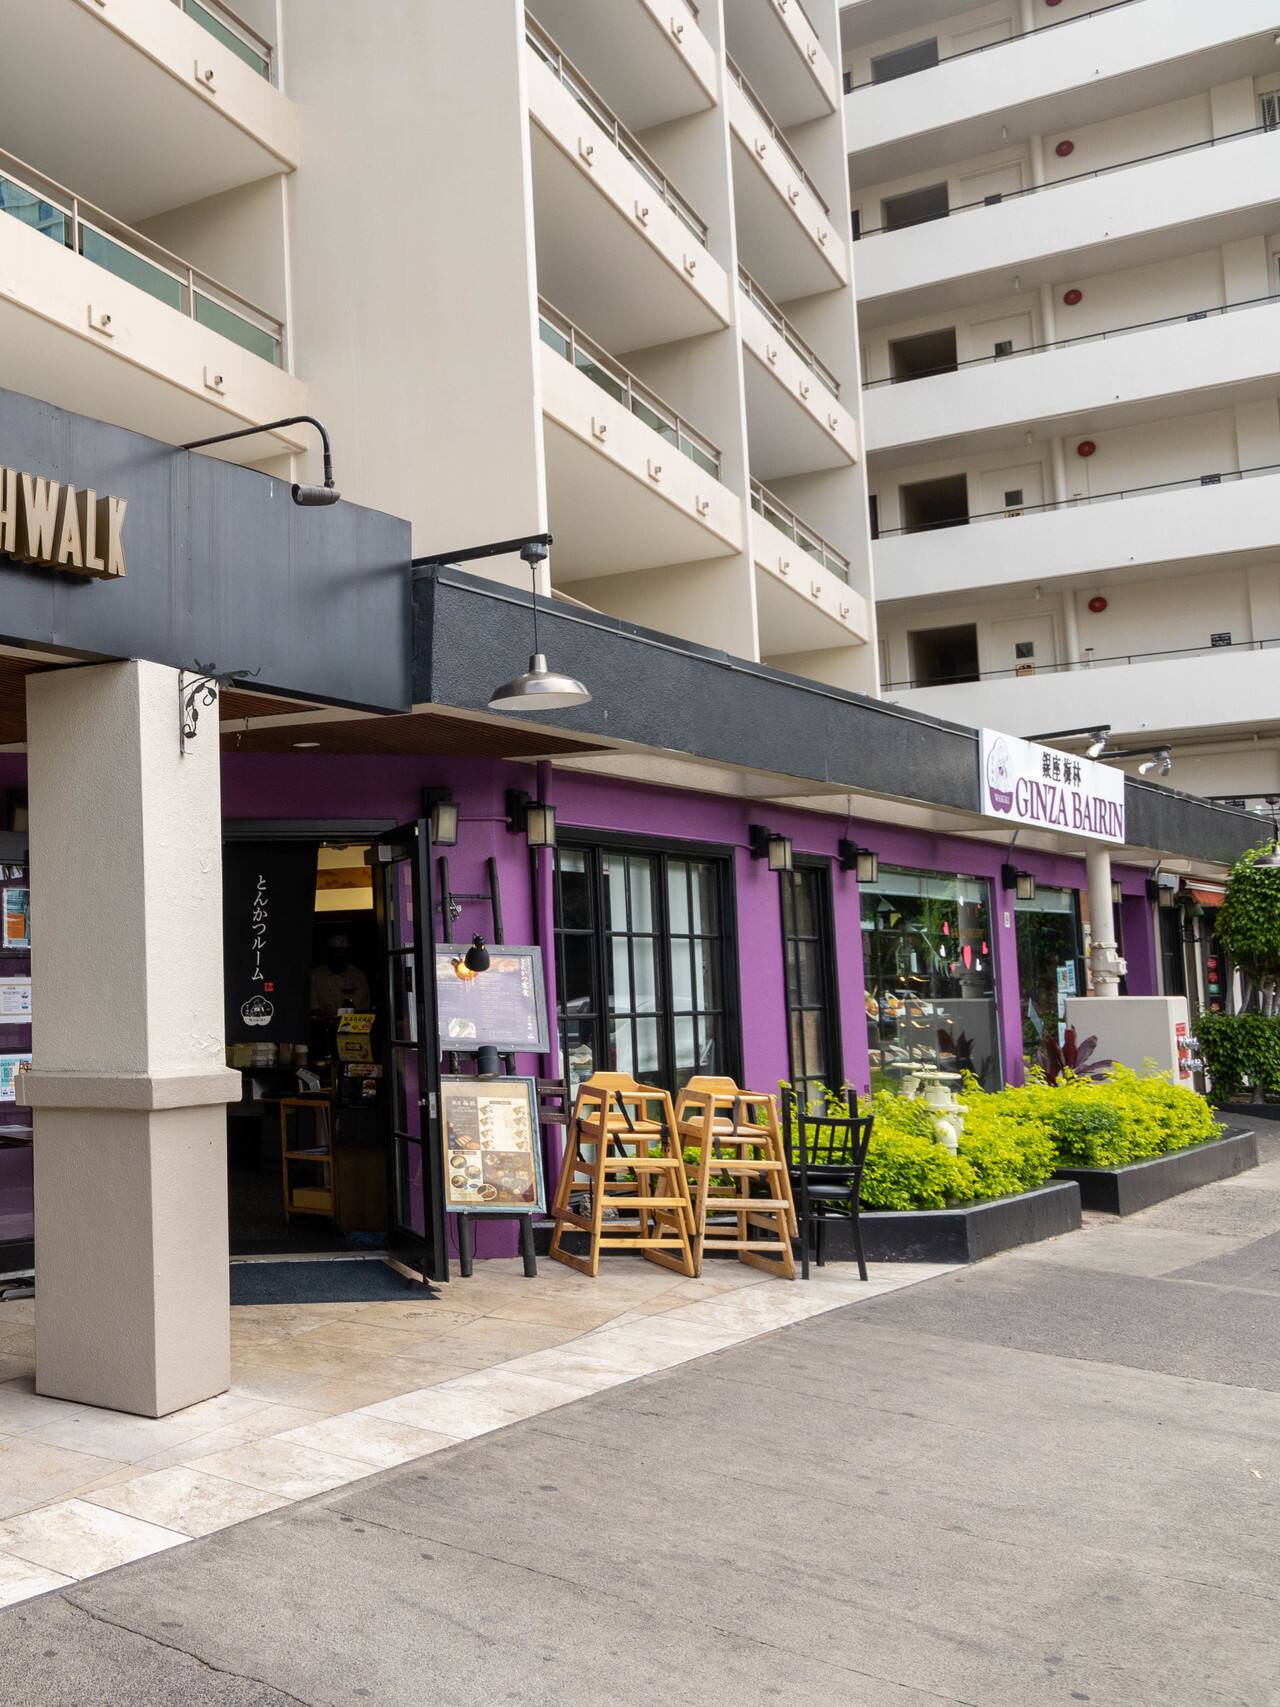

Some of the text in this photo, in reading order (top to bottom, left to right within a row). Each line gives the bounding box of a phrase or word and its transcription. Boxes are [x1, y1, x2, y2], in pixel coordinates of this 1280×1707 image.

[1015, 777, 1124, 839] GINZA BAIRIN
[251, 874, 269, 981] とんかつルーム
